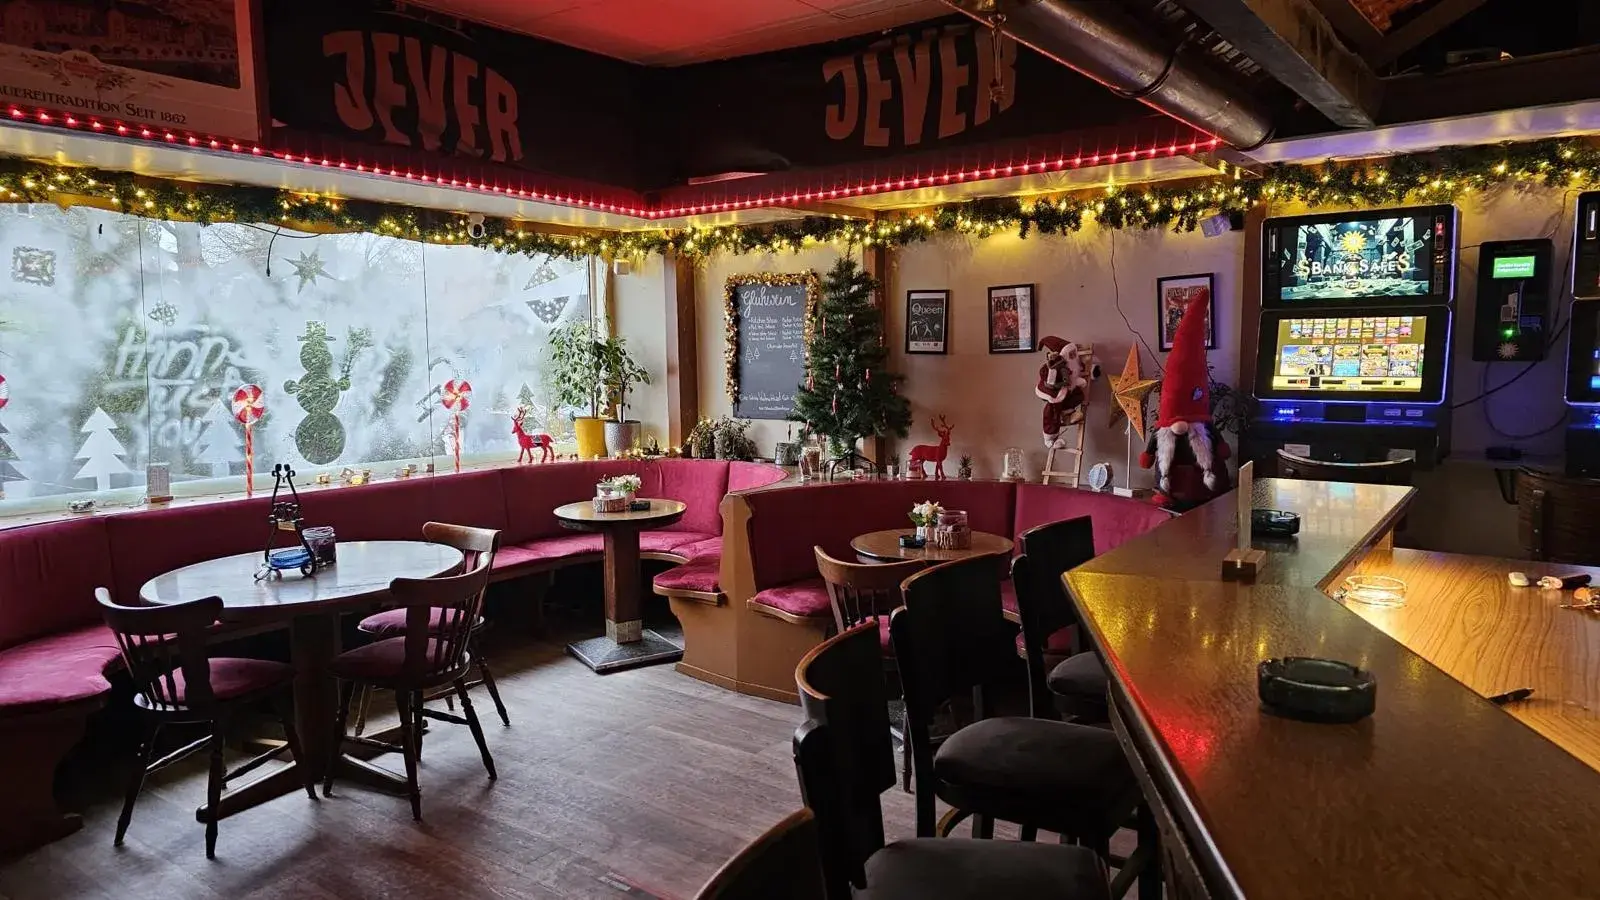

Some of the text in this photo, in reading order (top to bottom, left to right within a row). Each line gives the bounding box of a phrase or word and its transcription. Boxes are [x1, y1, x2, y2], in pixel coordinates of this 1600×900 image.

[160, 112, 187, 125] 1862
[321, 30, 524, 163] JEVER
[822, 24, 1018, 147] JEVER
[911, 302, 943, 317] Queen
